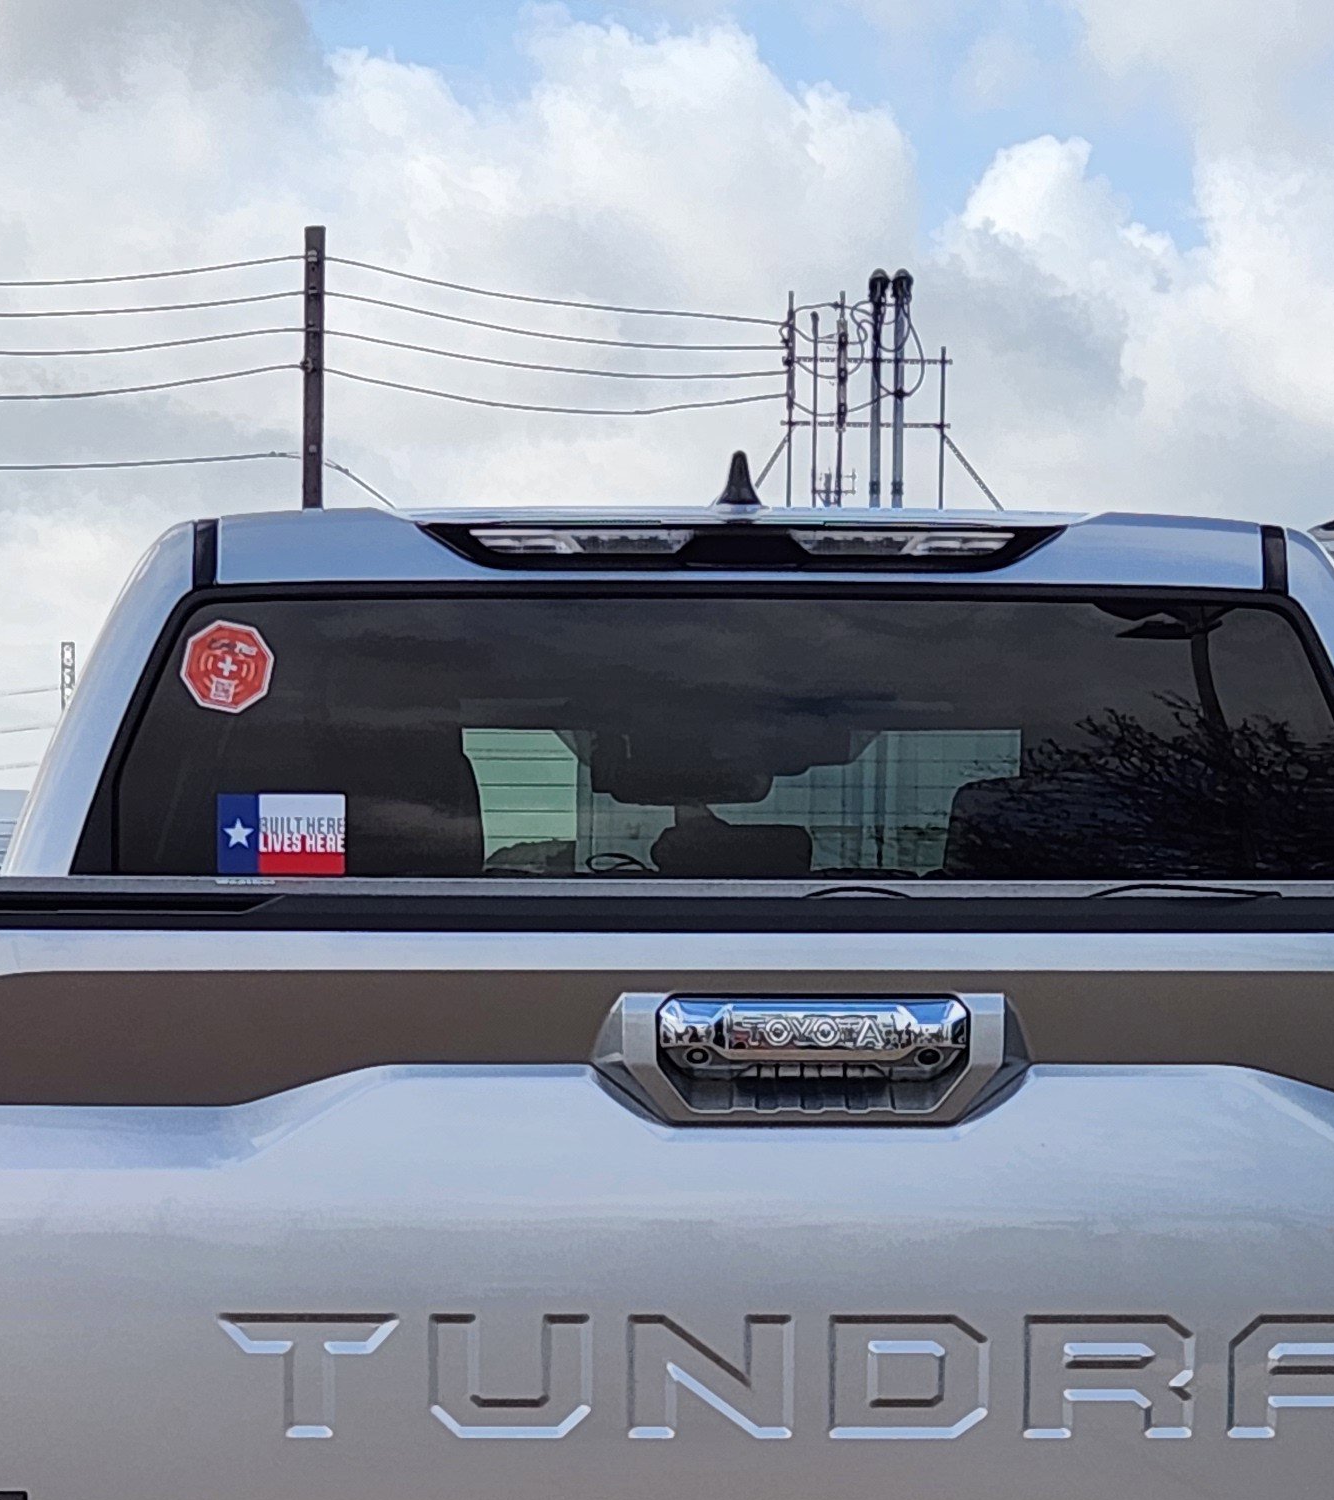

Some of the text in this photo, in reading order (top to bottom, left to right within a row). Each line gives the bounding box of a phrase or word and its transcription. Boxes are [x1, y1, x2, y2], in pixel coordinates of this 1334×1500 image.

[260, 817, 344, 834] BUILT HERE
[259, 833, 345, 852] LIVES HERE
[743, 1016, 885, 1048] TOYOTA
